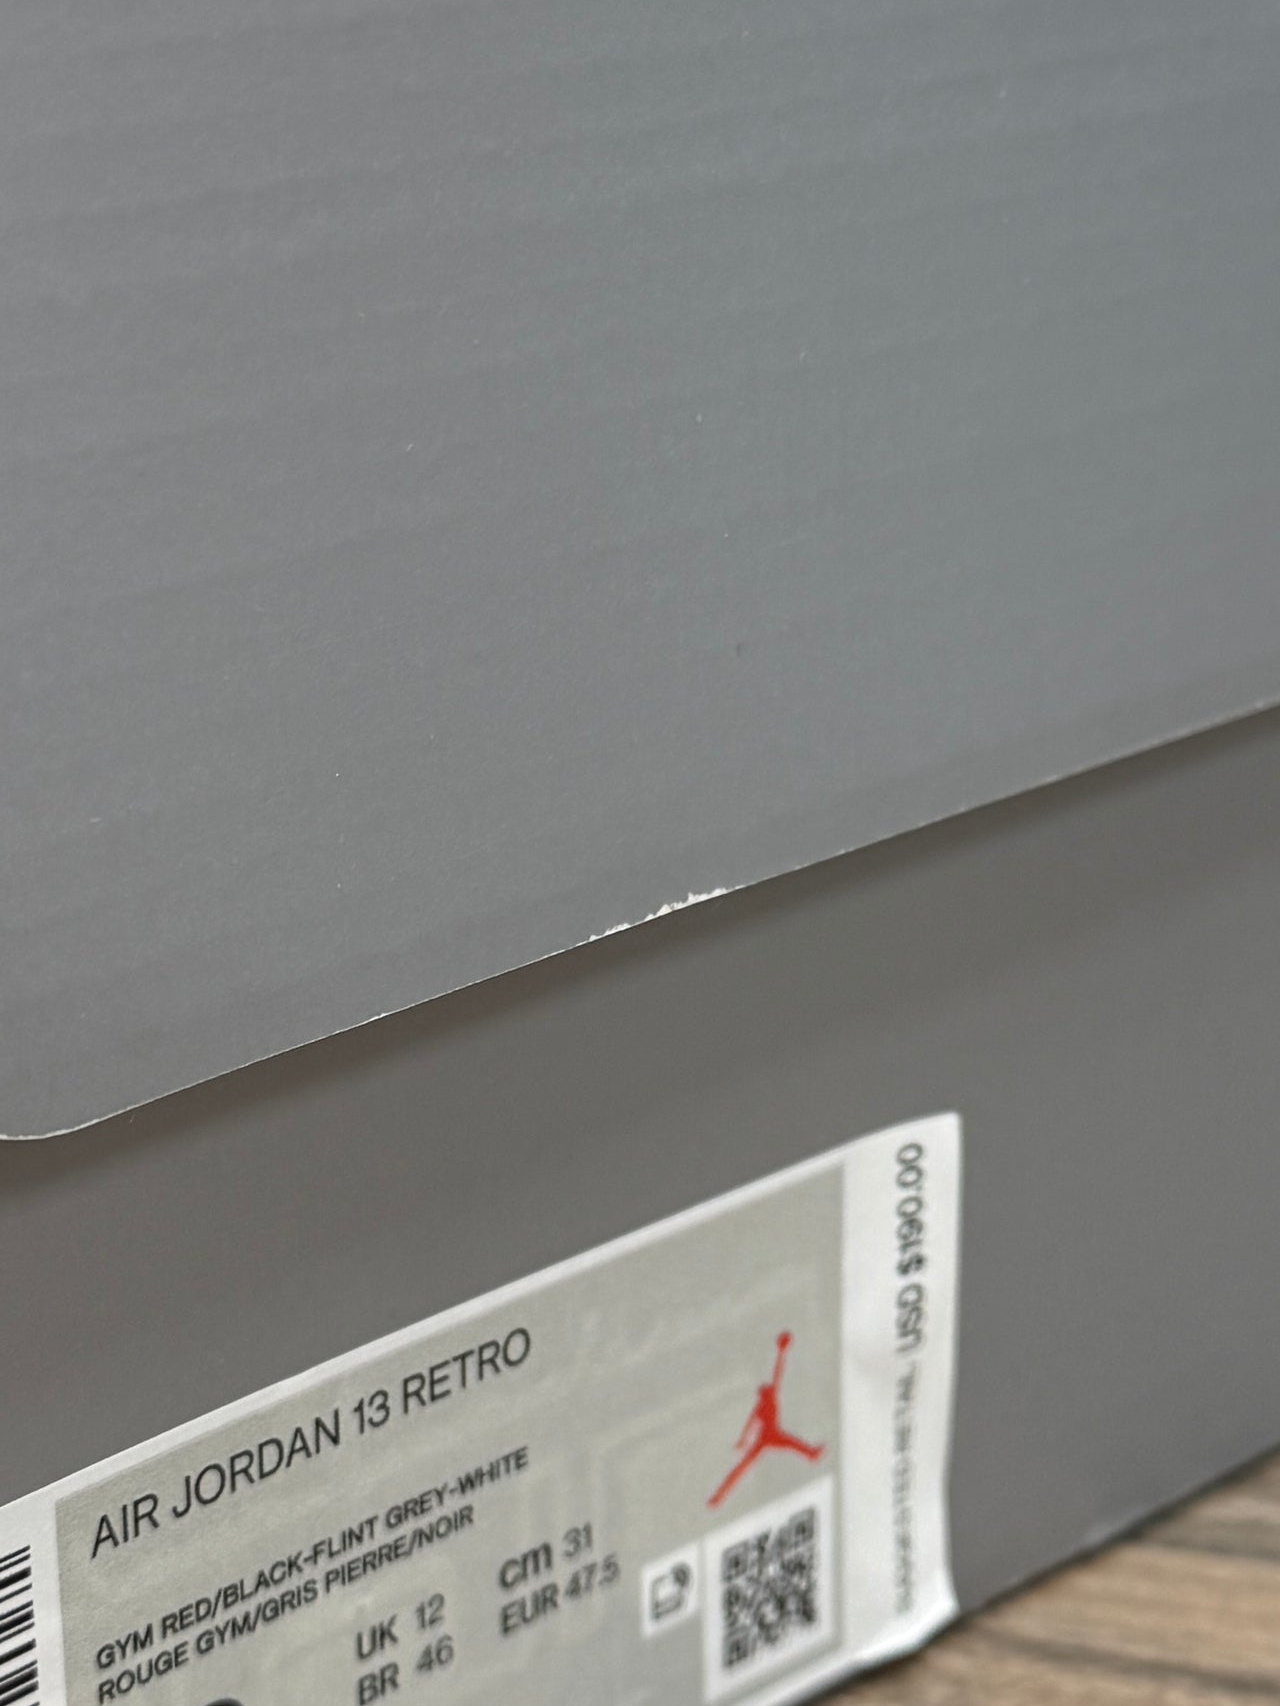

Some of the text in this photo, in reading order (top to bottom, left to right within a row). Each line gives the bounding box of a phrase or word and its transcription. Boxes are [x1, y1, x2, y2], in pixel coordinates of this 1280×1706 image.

[897, 1143, 926, 1276] $190.00
[897, 1283, 923, 1353] USD
[89, 1327, 532, 1559] AIR JORDAN 13 RETRO
[95, 1446, 529, 1671] GYM RED/BLACK-FLINT GREY-WHITE
[499, 1522, 593, 1588] cm 31
[97, 1505, 474, 1705] ROUGE GYM/GRIS PIERRE/NOIR
[356, 1594, 446, 1661] UK 12
[501, 1584, 560, 1637] EUR
[417, 1634, 455, 1673] 46
